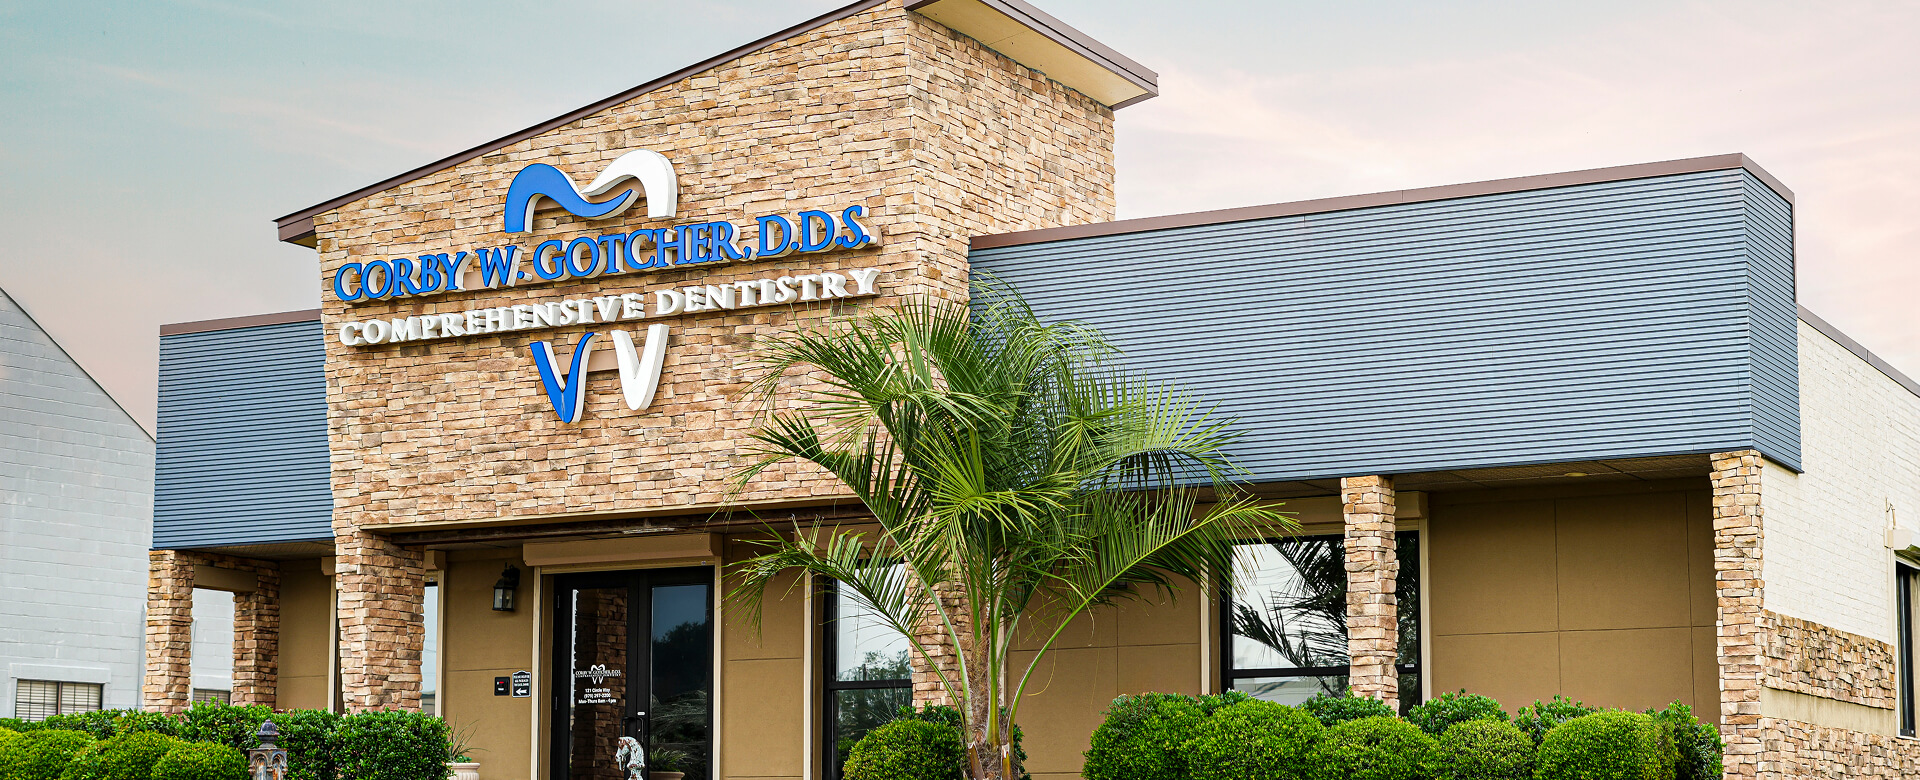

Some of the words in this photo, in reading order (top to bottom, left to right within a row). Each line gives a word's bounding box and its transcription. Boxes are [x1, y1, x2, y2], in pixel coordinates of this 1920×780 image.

[334, 251, 471, 302] CORBY
[476, 245, 529, 289] W.
[533, 220, 756, 281] GOTCHER,
[756, 205, 874, 258] D.D.S.
[339, 293, 645, 346] COMPREHENSIVE
[654, 267, 881, 315] DENTISTRY
